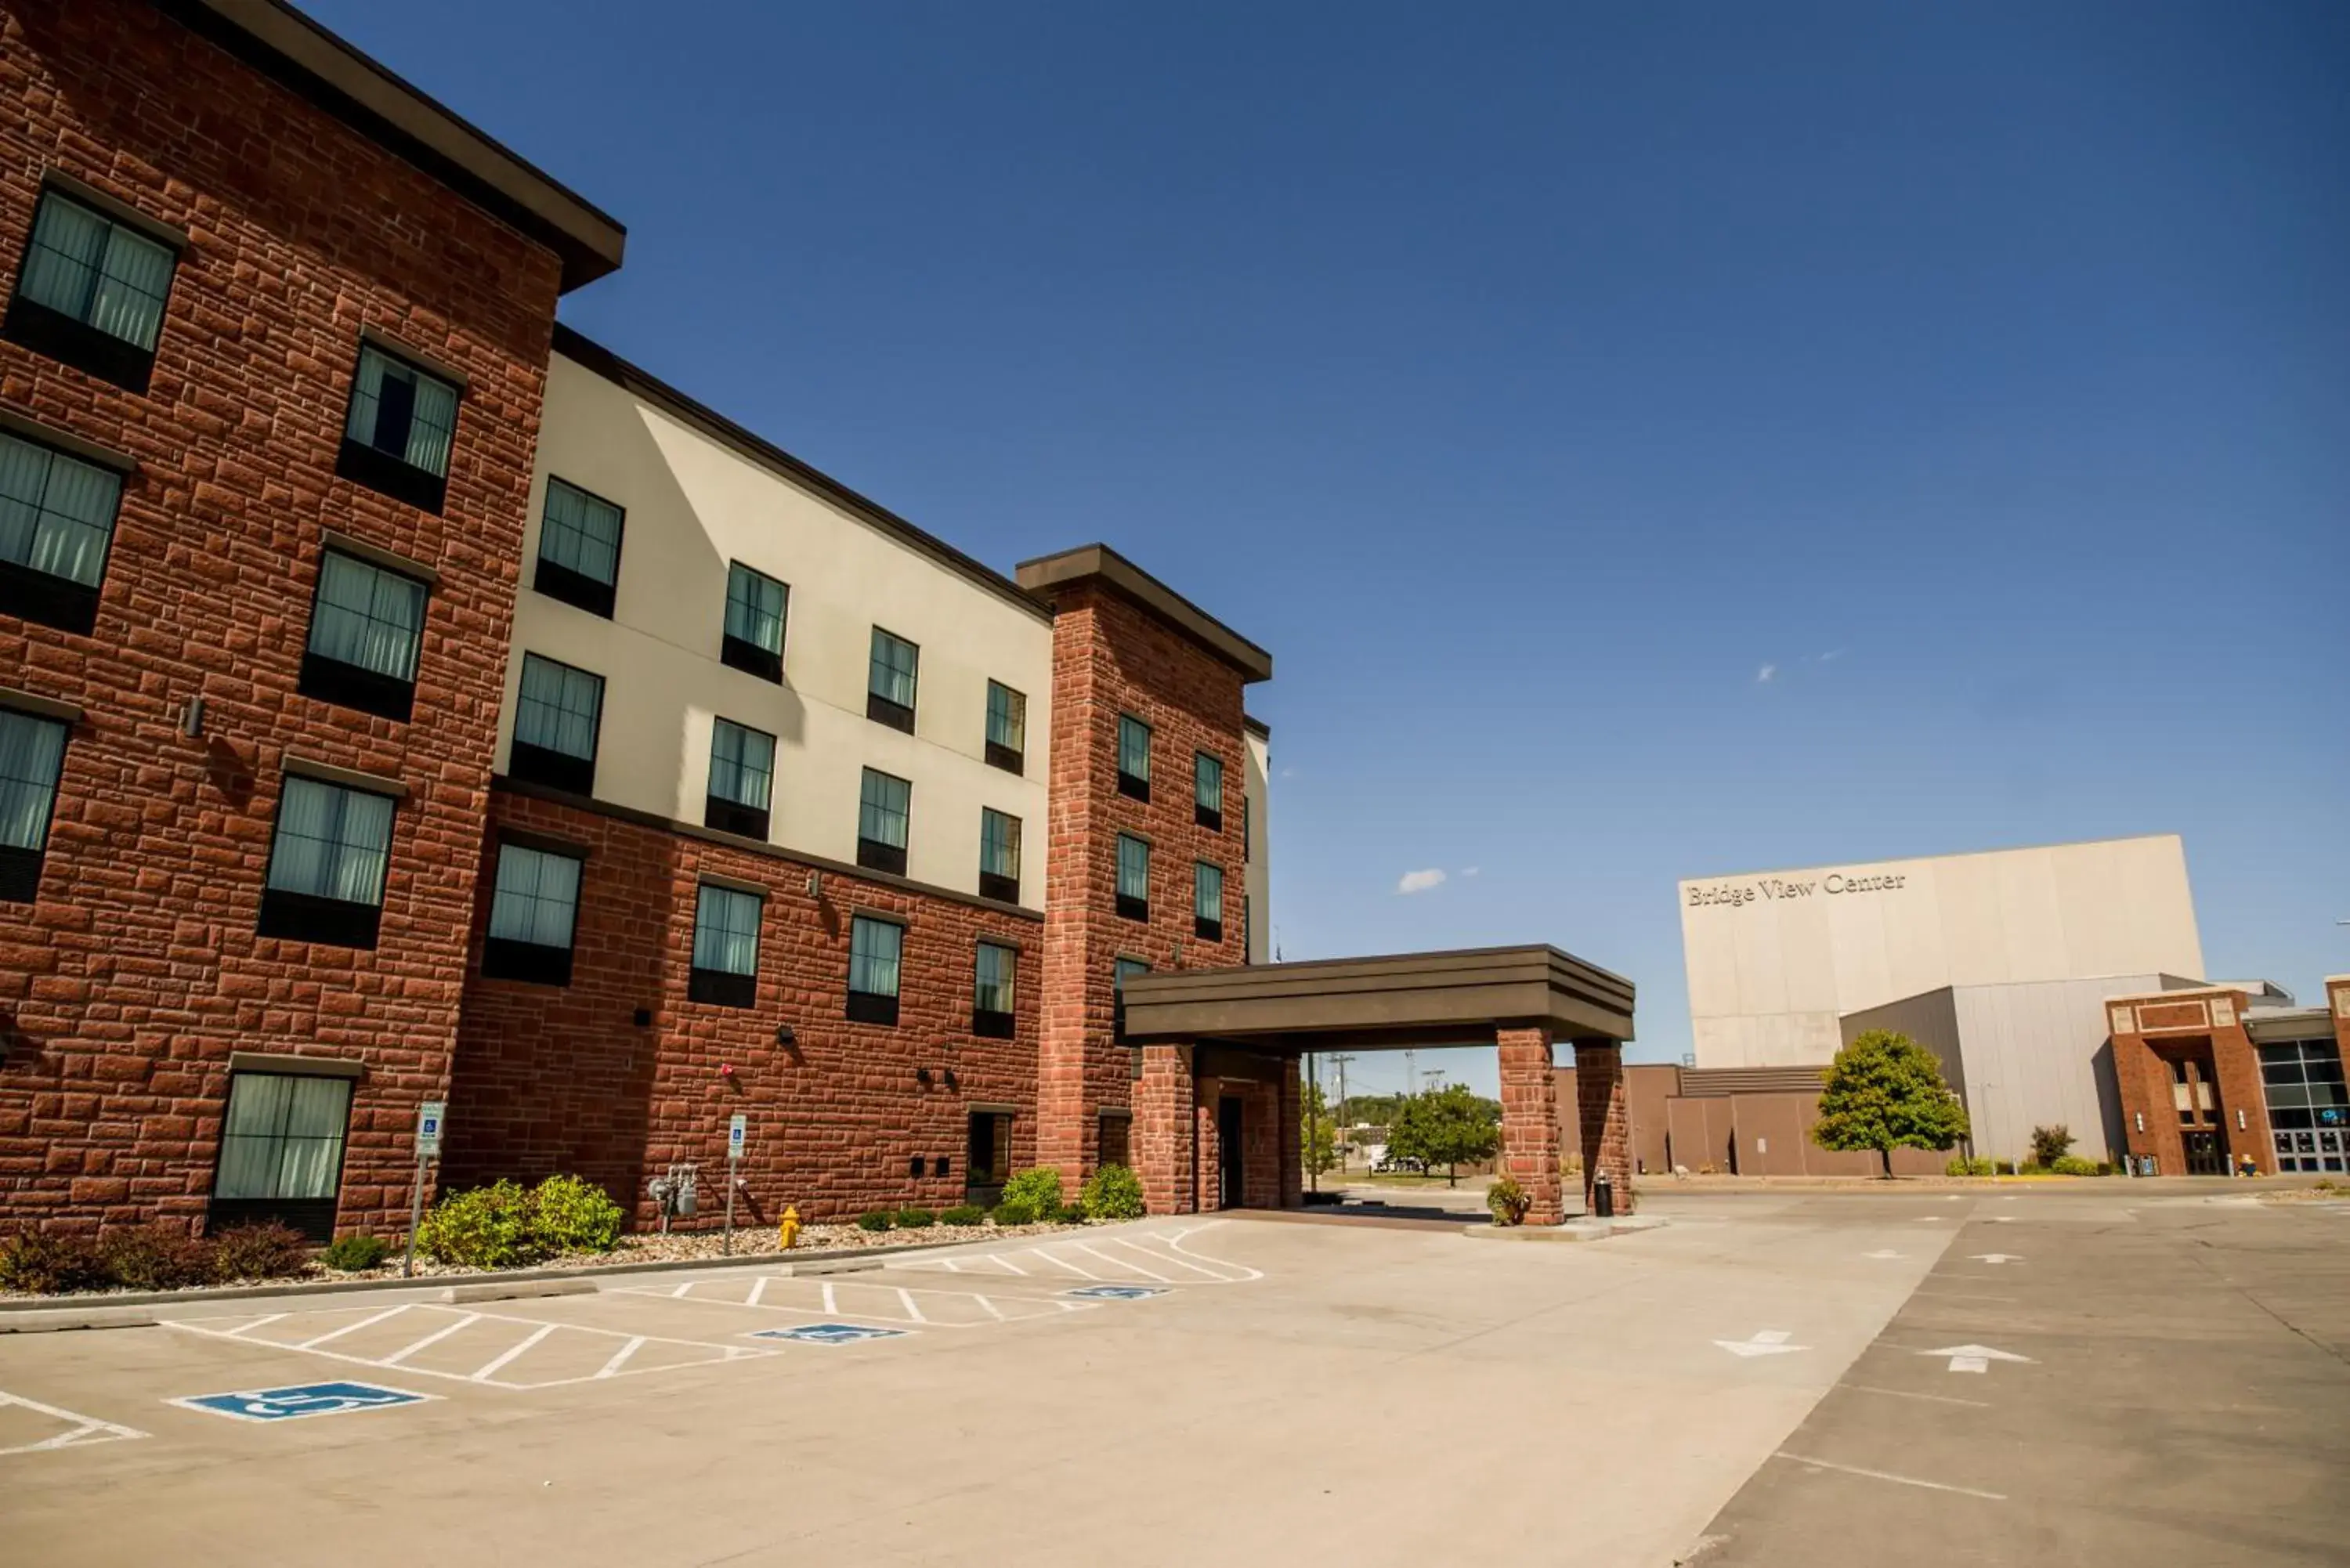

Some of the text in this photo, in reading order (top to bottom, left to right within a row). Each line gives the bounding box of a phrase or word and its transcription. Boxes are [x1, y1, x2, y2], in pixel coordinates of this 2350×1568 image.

[1687, 874, 1905, 907] Bridge View Center
